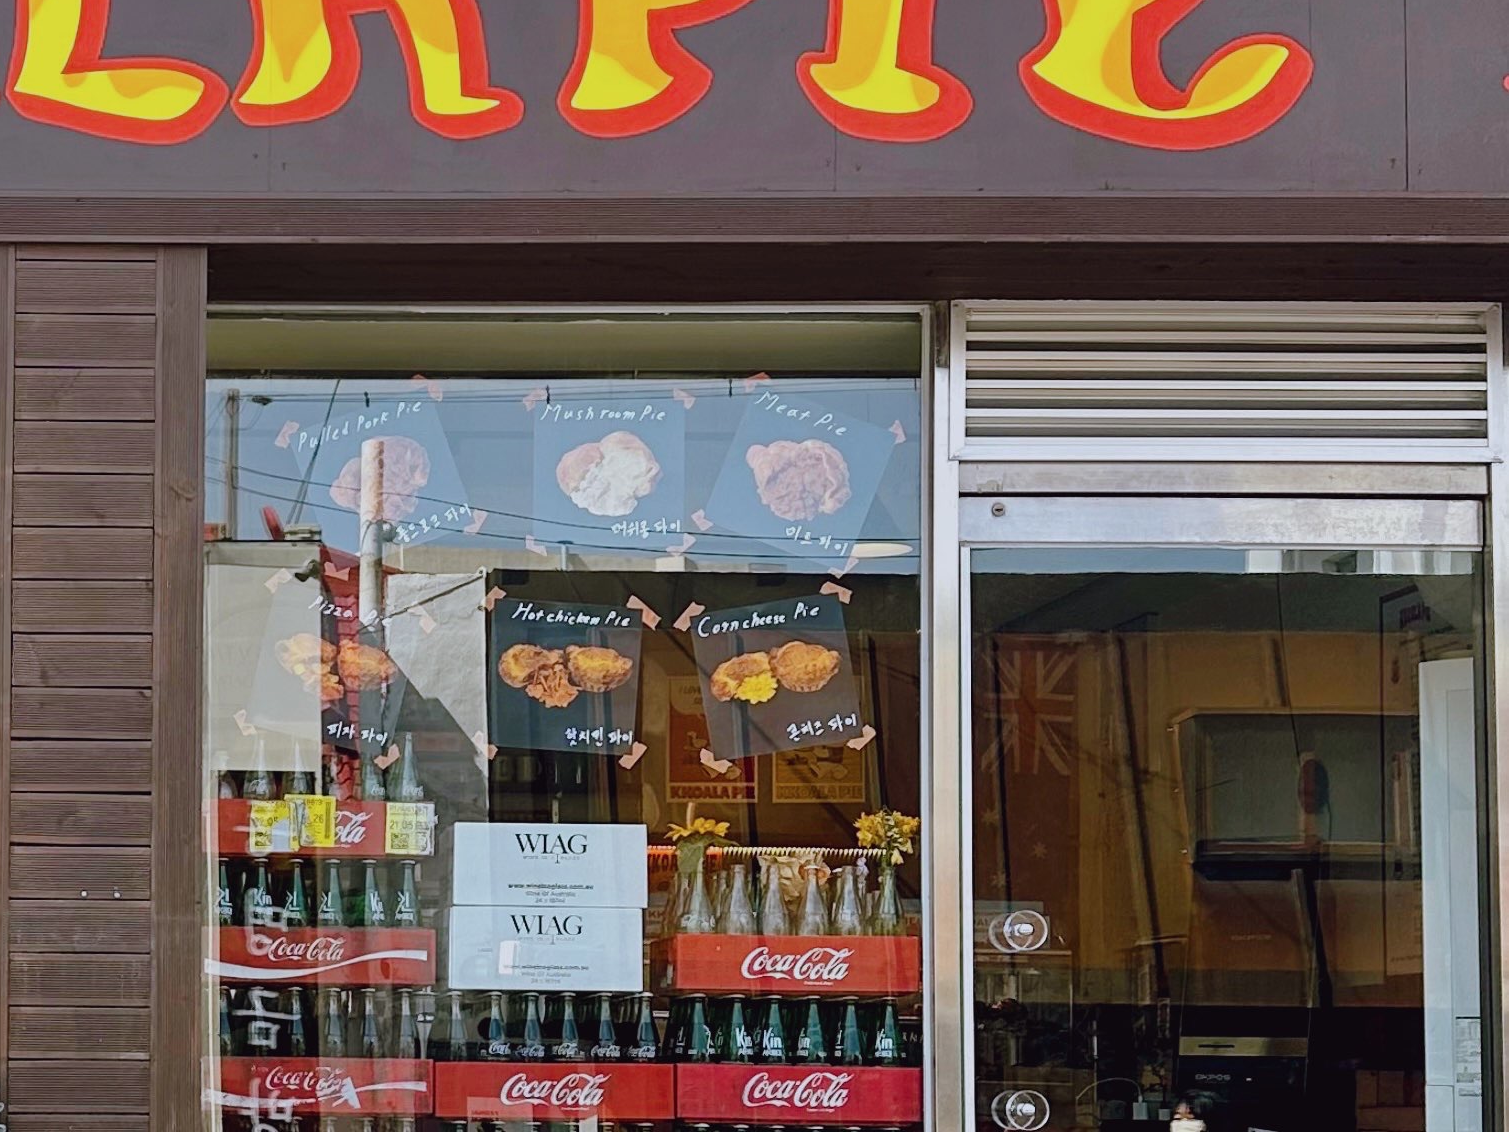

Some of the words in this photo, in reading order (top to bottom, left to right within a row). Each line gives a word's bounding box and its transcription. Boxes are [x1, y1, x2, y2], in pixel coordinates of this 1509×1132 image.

[640, 405, 666, 420] Pie
[755, 391, 810, 420] Meat
[814, 414, 847, 436] Pie
[298, 421, 349, 452] Pulled
[357, 411, 389, 432] Pork
[397, 401, 422, 417] Pie
[654, 518, 681, 534] 파이
[308, 596, 353, 618] Pizza
[794, 601, 820, 620] Pie
[605, 610, 630, 627] Pie
[827, 713, 857, 732] 파이
[327, 722, 355, 739] 피자
[361, 728, 388, 746] 파이
[608, 729, 633, 746] 파이
[515, 833, 588, 854] WIAG
[253, 887, 272, 905] Kin
[510, 914, 583, 935] WIAG
[741, 946, 855, 981] Coca-Cola
[763, 1027, 782, 1047] Kin
[875, 1028, 893, 1048] Kin
[500, 1073, 612, 1106] Coca-Cola
[742, 1072, 854, 1108] Coca-Cola
